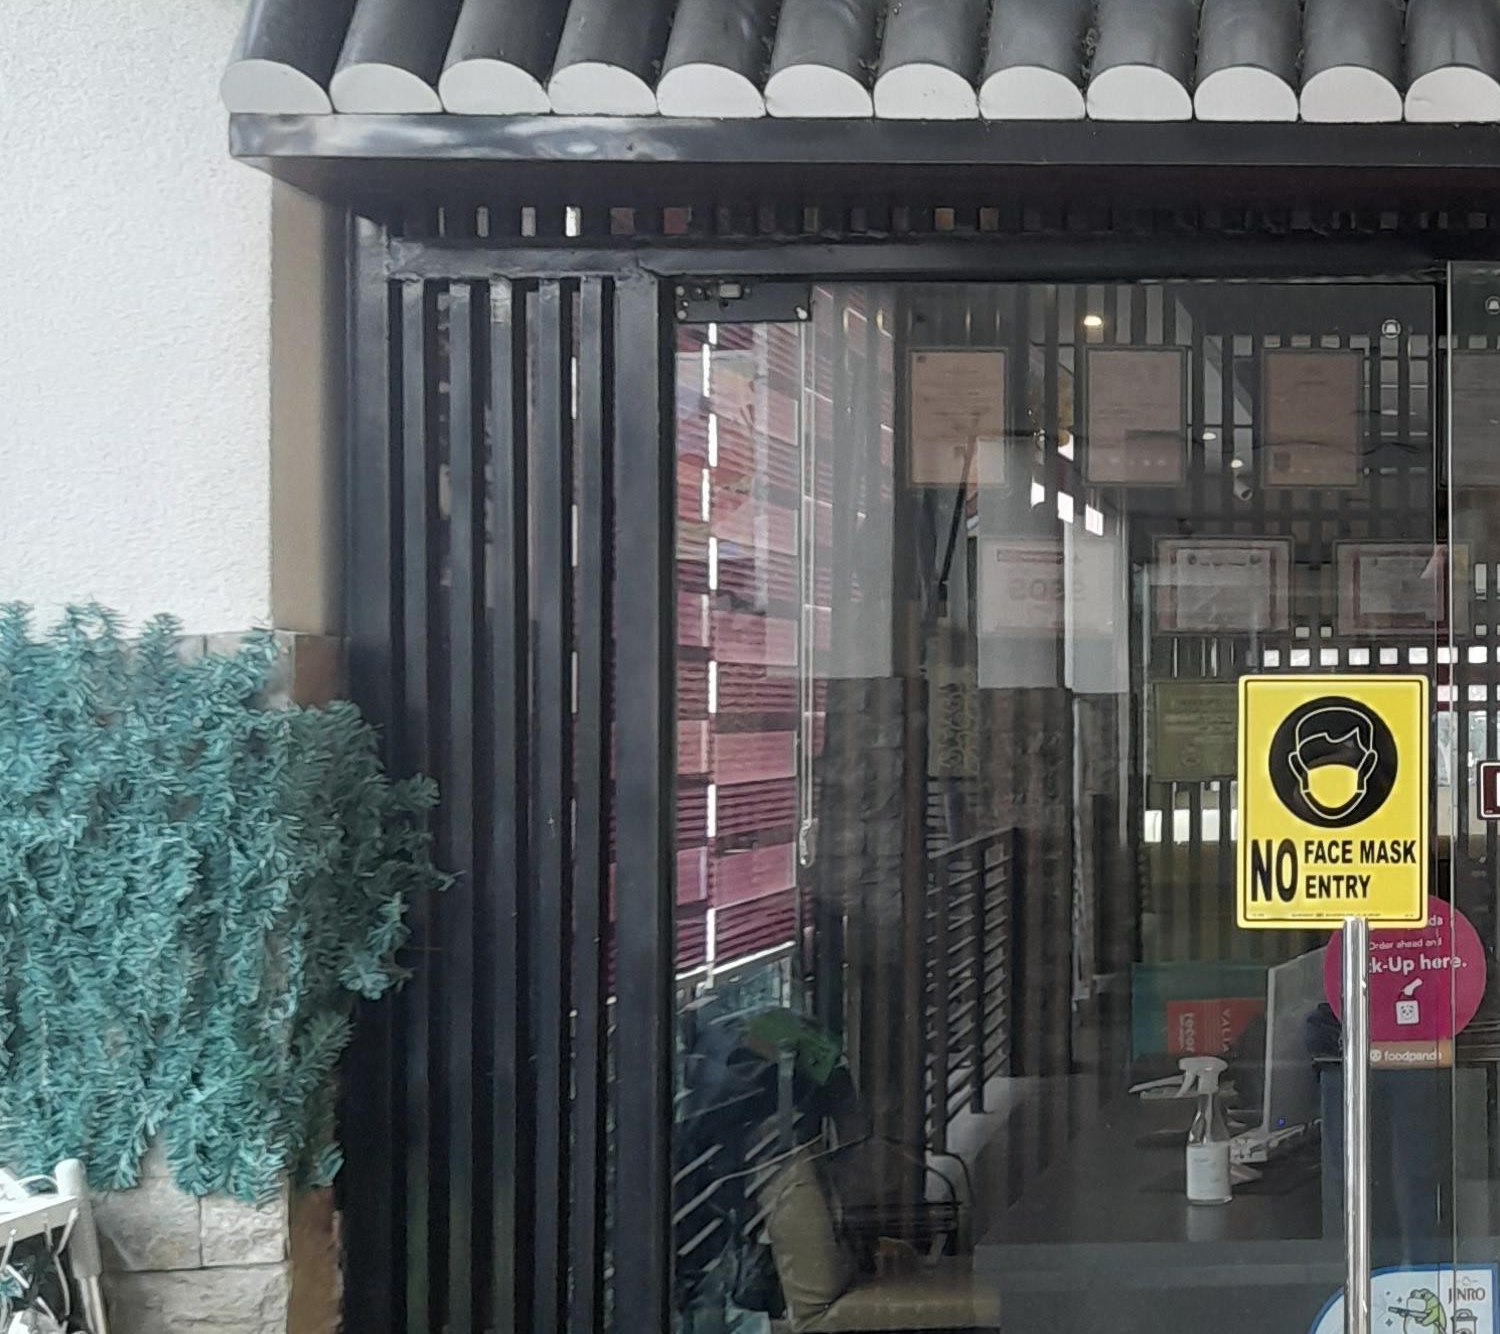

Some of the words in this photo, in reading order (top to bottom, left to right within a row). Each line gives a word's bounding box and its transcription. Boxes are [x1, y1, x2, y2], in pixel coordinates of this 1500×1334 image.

[1304, 839, 1353, 865] FACE
[1360, 839, 1417, 864] MASK
[1250, 838, 1298, 903] NO
[1305, 874, 1371, 899] ENTRY
[1369, 941, 1393, 951] Order
[1397, 939, 1423, 948] ahead
[1369, 955, 1415, 975] k-Up
[1420, 953, 1468, 970] here.
[1448, 1287, 1486, 1304] JNRO
